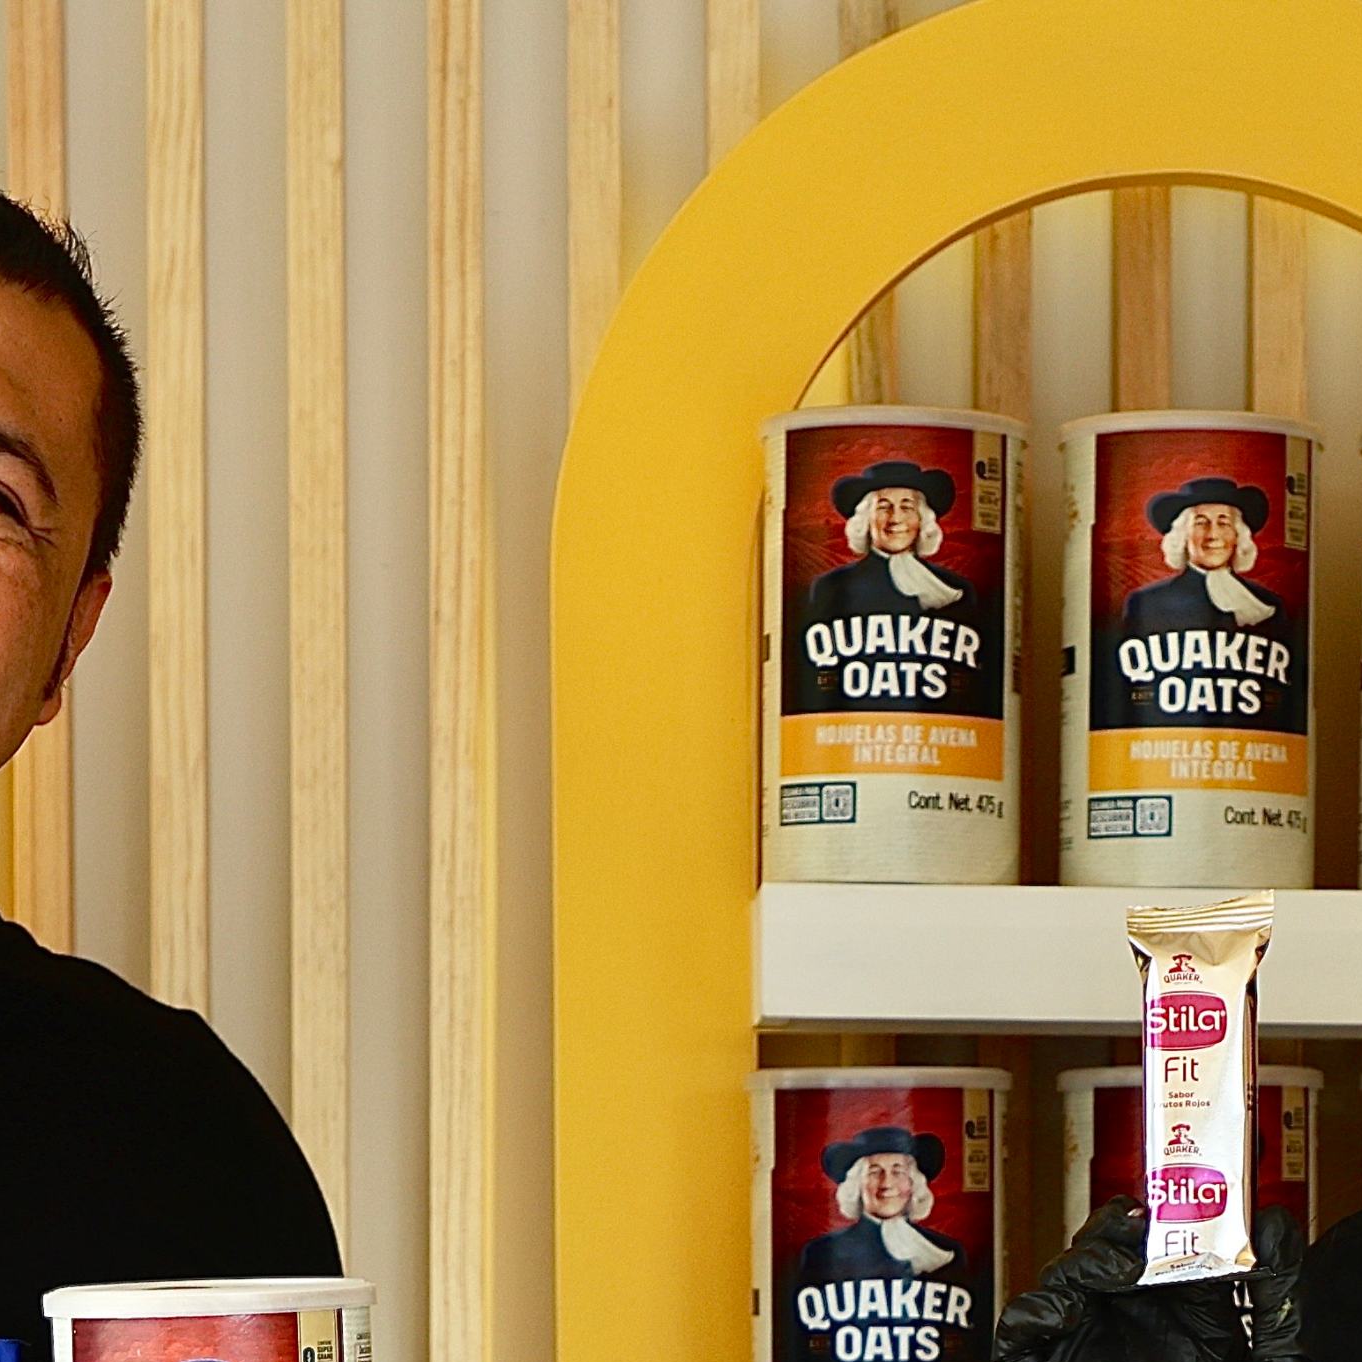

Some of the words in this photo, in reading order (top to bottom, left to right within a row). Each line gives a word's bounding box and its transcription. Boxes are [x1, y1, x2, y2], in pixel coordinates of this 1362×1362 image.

[805, 615, 981, 667] QUAKER
[1118, 630, 1292, 684] QUAKER
[843, 661, 948, 699] OATS
[1158, 676, 1262, 715] OATS
[815, 725, 897, 746] HOJUELAS
[903, 726, 924, 745] DE
[929, 727, 978, 747] AVENA
[853, 745, 941, 765] INTEGRAL
[1129, 740, 1214, 761] HOJUELAS
[1219, 741, 1240, 761] DE
[1245, 742, 1288, 763] AVENA
[1170, 760, 1256, 781] INTEGRAL
[908, 790, 945, 810] Cont.
[948, 791, 973, 812] Net.
[1224, 806, 1259, 826] Cont.
[1262, 807, 1284, 828] Net.
[1163, 972, 1201, 984] QUAKER
[1147, 1006, 1221, 1034] Stila
[1165, 1056, 1199, 1083] Fit
[1168, 1091, 1195, 1099] Sabor
[1185, 1100, 1211, 1108] Rojos
[1163, 1145, 1200, 1156] QUAKER
[1165, 1230, 1200, 1256] Fit
[797, 1279, 972, 1330] QUAKER
[835, 1326, 940, 1362] OATS
